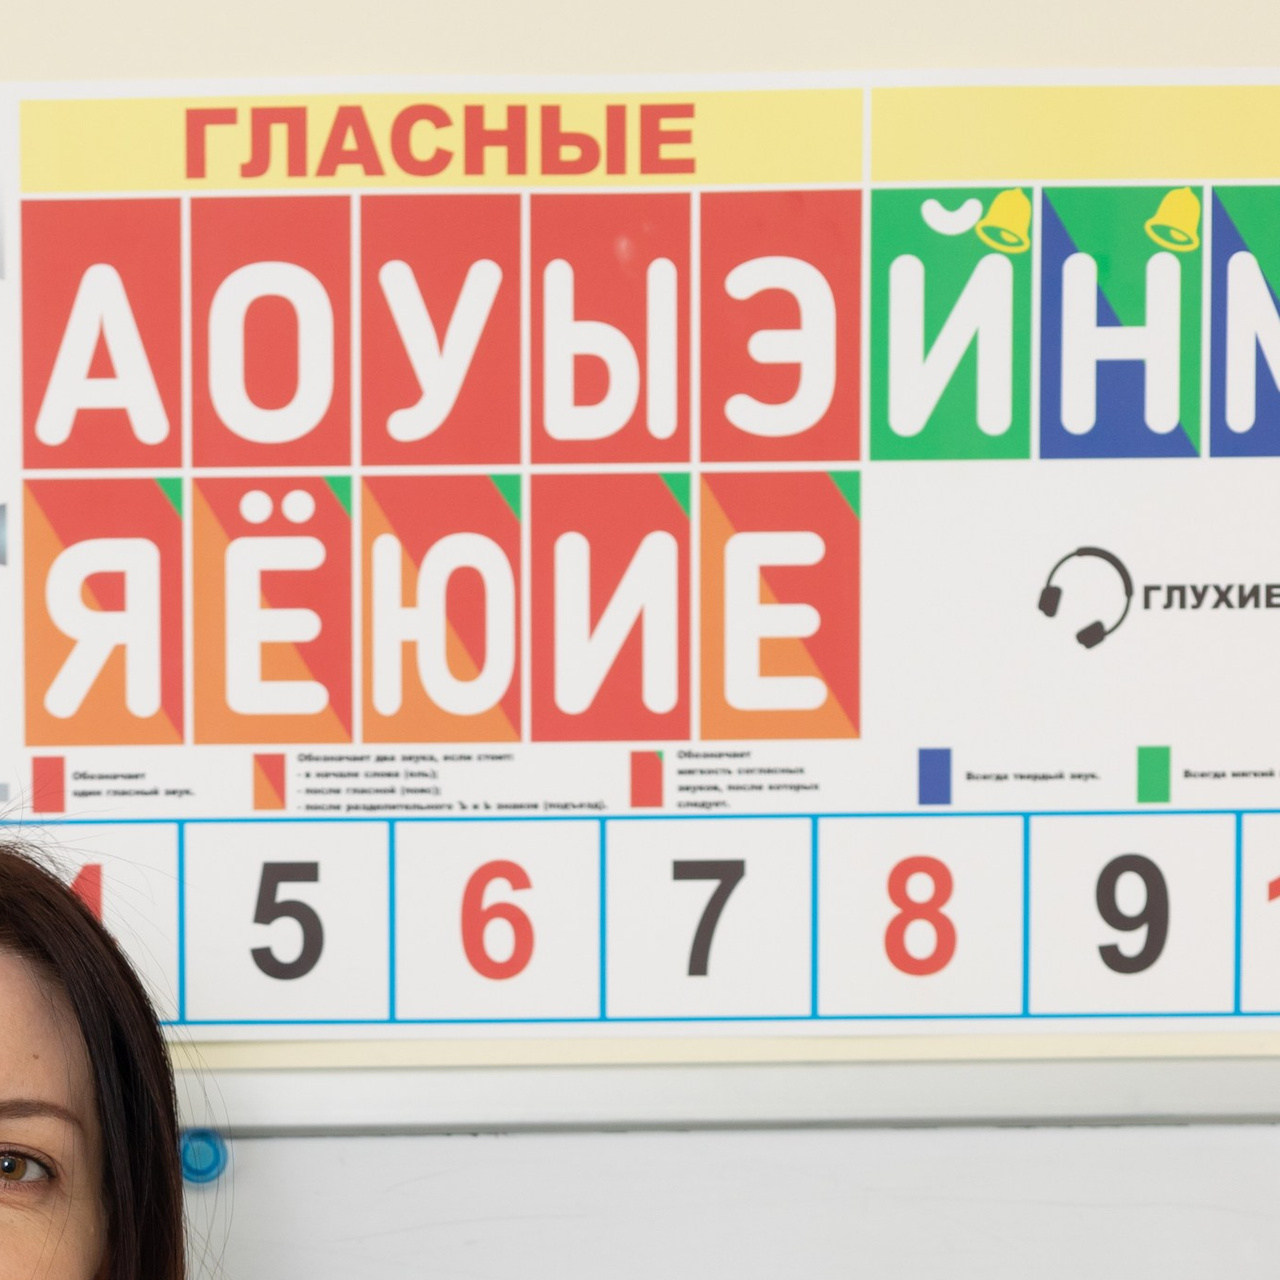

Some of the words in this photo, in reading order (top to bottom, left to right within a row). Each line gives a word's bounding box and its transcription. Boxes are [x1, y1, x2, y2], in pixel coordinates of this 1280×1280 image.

[184, 103, 697, 179] ГЛАСНЫЕ
[36, 264, 169, 445] А
[209, 262, 333, 443] О
[380, 260, 501, 441] У
[544, 258, 677, 439] Ы
[725, 257, 835, 436] Э
[888, 198, 1014, 438] Й
[1060, 251, 1182, 435] Н
[43, 537, 162, 718] Я
[225, 489, 329, 715] Ё
[371, 531, 516, 716] Ю
[553, 530, 678, 715] И
[723, 530, 828, 711] Е
[1144, 585, 1280, 609] ГЛУХИЕ
[251, 862, 323, 980] 5
[460, 859, 535, 980] 6
[673, 860, 744, 976] 7
[883, 855, 957, 977] 8
[1096, 854, 1169, 974] 9
